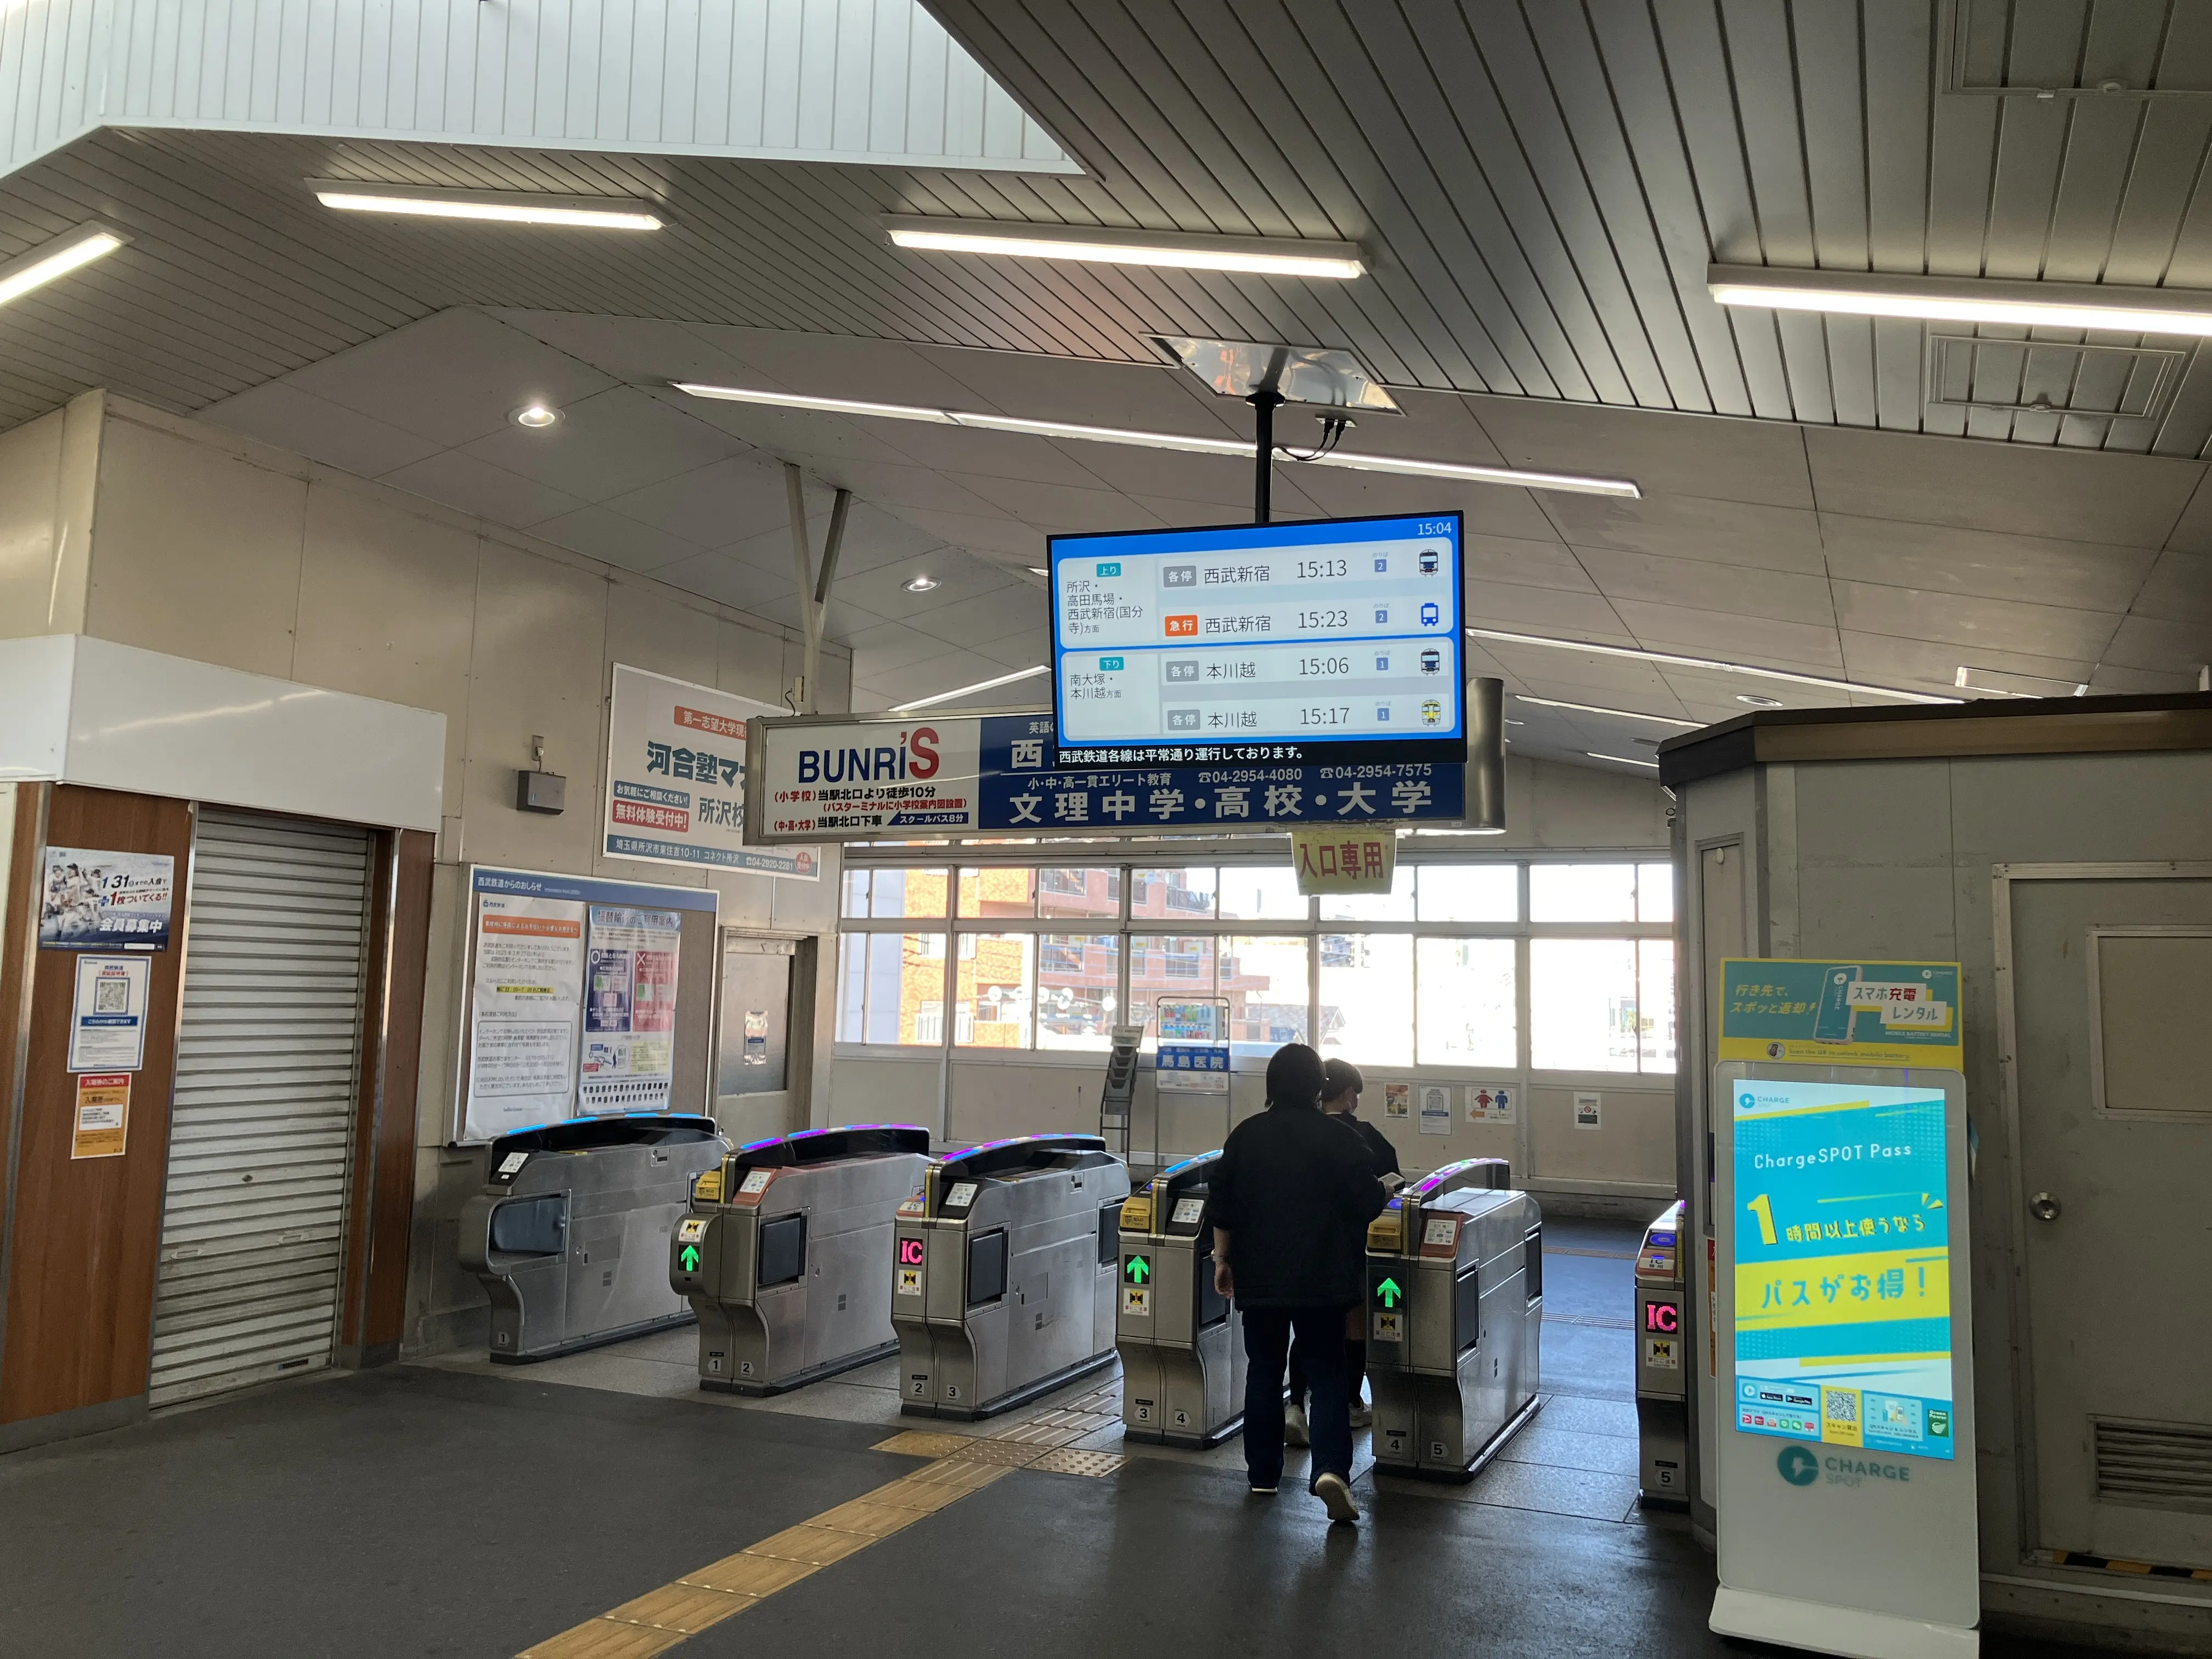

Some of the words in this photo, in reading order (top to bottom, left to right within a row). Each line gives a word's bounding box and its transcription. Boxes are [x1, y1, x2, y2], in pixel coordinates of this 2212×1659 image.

[1418, 522, 1452, 536] 15:04
[1099, 565, 1117, 575] 上り
[1168, 570, 1192, 583] 各停
[1204, 565, 1270, 584] 西武新宿
[1297, 560, 1347, 579] 15:13
[1377, 561, 1384, 570] 2
[1169, 620, 1193, 632] 急行
[1205, 615, 1271, 634] 西武新宿
[1298, 610, 1348, 629] 15:23
[1378, 612, 1385, 622] 2
[1103, 659, 1120, 669] 下り
[1171, 665, 1194, 678] 各停
[1206, 662, 1256, 679] 本川越
[1299, 657, 1349, 676] 15:06
[1380, 659, 1385, 669] 1
[1070, 686, 1121, 699] 本川越方面
[1172, 714, 1195, 726] 各停
[1207, 711, 1257, 729] 本川越
[1300, 707, 1350, 725] 15:17
[1381, 710, 1386, 719] 1
[1059, 746, 1303, 764] 西武鉄道各線は平常通り運行しております。
[1028, 772, 1172, 789] 小・中・高一貫エリート教育
[1212, 769, 1302, 785] 04-2954-4080
[1335, 764, 1432, 779] 04-2954-7575
[775, 790, 816, 803] (小学校)
[819, 787, 935, 801] 当駅北口より徒歩10分
[1009, 781, 1432, 823] 文理中学・高校・大学
[616, 803, 686, 828] 無料体験受付中!
[818, 815, 882, 828] 当駅北口下車
[900, 814, 963, 823] スクールバス8分
[1299, 842, 1384, 880] 入口専用
[478, 877, 541, 891] 西武鉄道からのおしらせ
[1735, 984, 1790, 997] 行き先で、
[1853, 988, 1916, 1002] スマホ充電
[1892, 1007, 1938, 1021] レンタル
[1754, 1145, 1863, 1169] ChargeSPOT
[1871, 1143, 1912, 1159] Pass
[1747, 1194, 1778, 1245] 1
[1786, 1214, 1926, 1242] 時間以上使うなら
[901, 1241, 922, 1263] IC
[1762, 1266, 1925, 1308] パスがお得!
[1647, 1305, 1676, 1330] IC
[713, 1361, 718, 1369] 1
[743, 1363, 749, 1372] 2
[915, 1383, 922, 1392] 2
[949, 1387, 956, 1396] 3
[1139, 1409, 1148, 1418] 3
[1177, 1414, 1185, 1423] 4
[1391, 1440, 1400, 1450] 4
[1434, 1444, 1442, 1454] 5
[1661, 1471, 1671, 1483] 5
[1825, 1457, 1910, 1482] CHARGE
